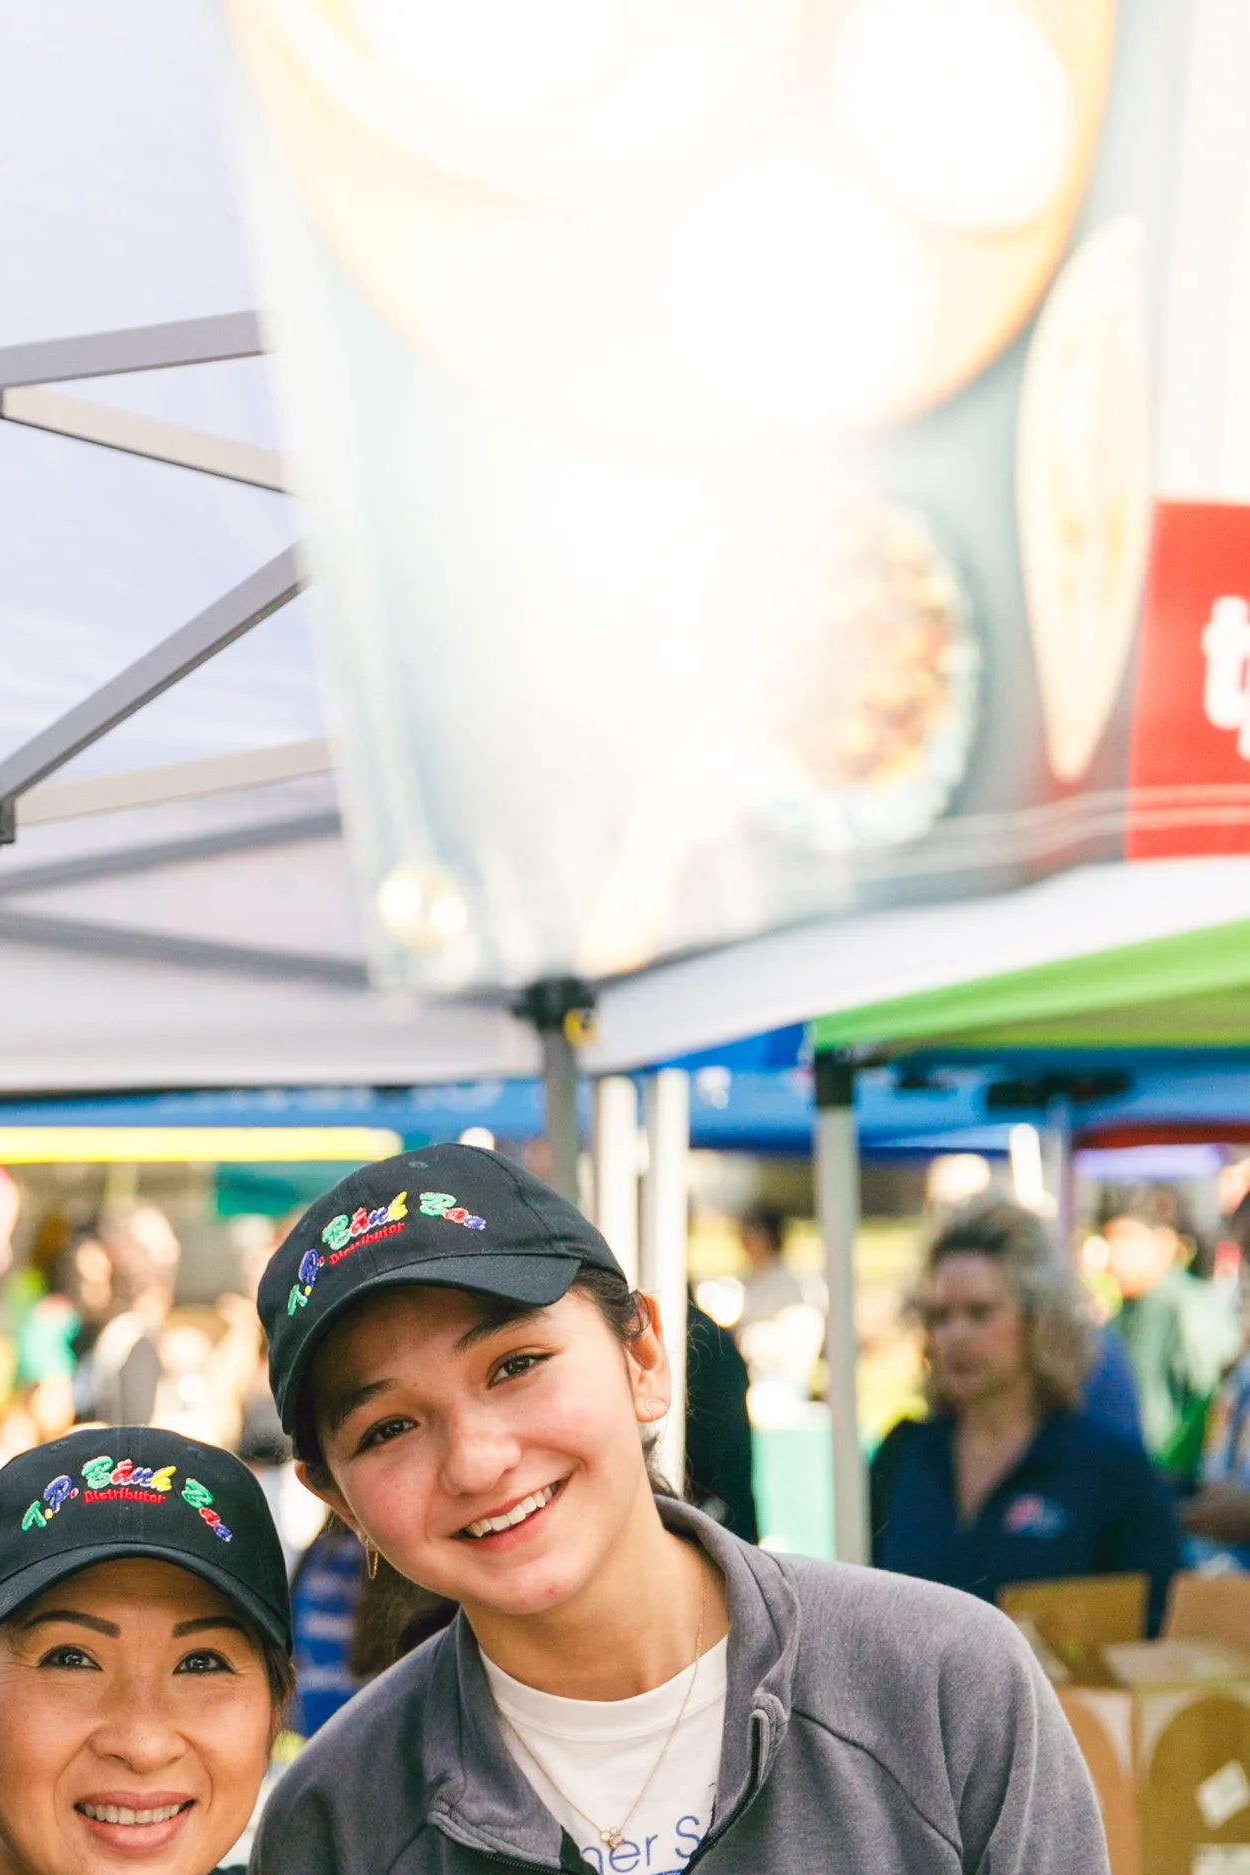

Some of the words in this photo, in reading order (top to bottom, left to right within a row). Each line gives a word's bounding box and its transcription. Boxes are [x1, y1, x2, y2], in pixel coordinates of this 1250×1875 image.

[419, 1191, 487, 1231] Bao
[329, 1221, 406, 1267] Distributor
[83, 1487, 166, 1505] Distributor
[181, 1477, 234, 1543] Bao
